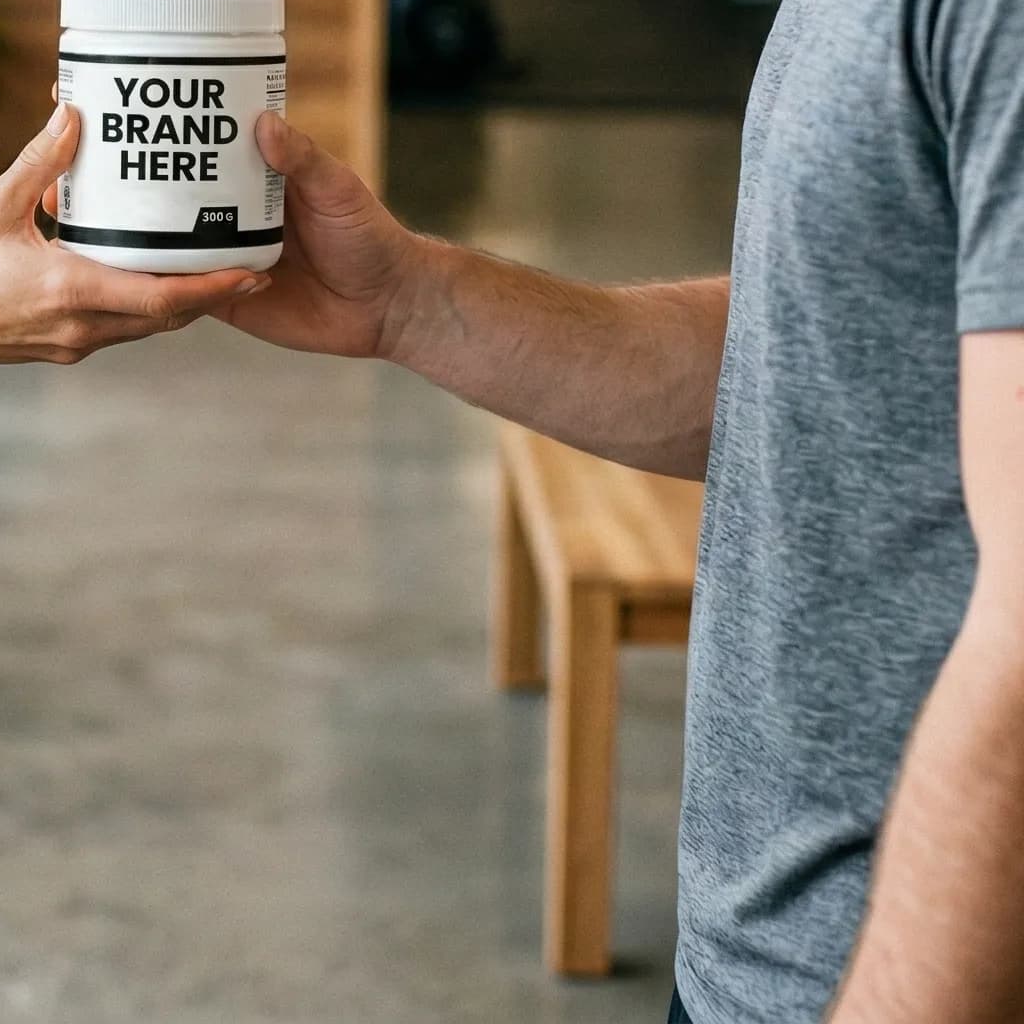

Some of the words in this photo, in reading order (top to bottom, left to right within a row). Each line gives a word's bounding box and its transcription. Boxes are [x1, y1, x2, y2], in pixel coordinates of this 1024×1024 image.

[114, 77, 225, 109] YOUR
[102, 112, 239, 145] BRAND
[120, 150, 219, 182] HERE
[202, 211, 224, 222] 300
[226, 212, 234, 222] G
